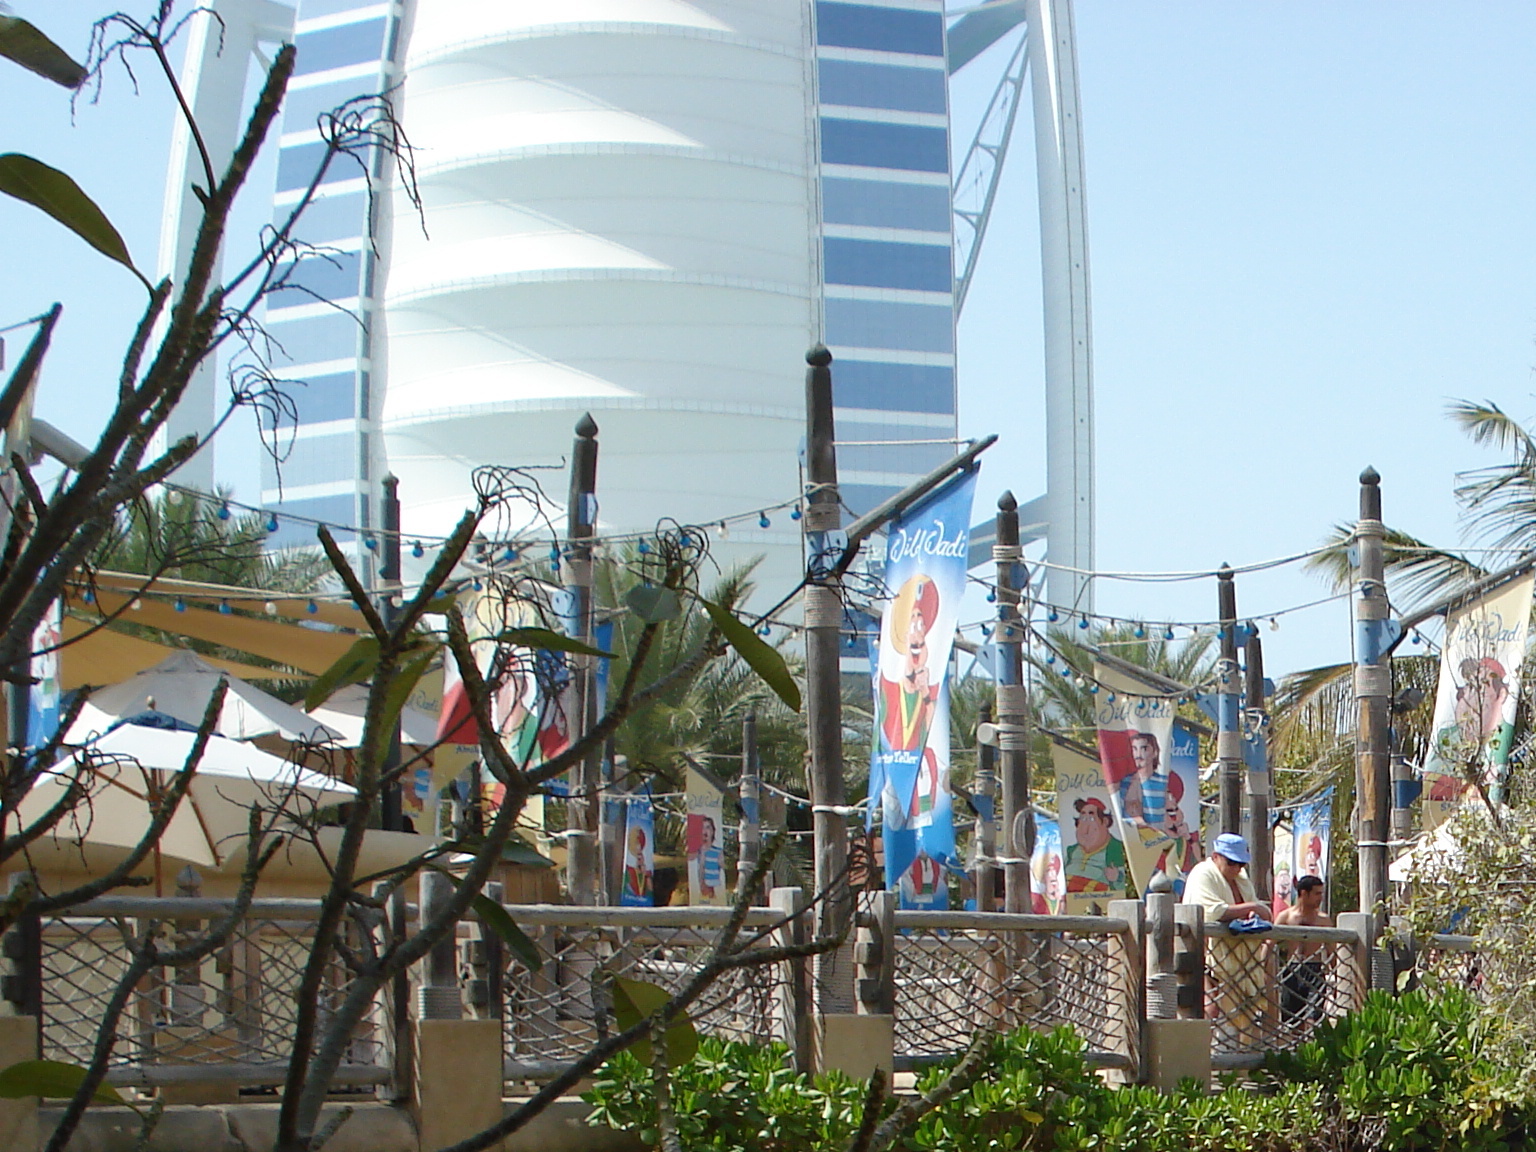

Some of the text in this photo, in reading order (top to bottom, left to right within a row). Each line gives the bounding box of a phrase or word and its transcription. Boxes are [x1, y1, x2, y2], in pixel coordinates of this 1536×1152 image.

[890, 520, 966, 563] Wild Wadi
[1100, 702, 1132, 724] Wild
